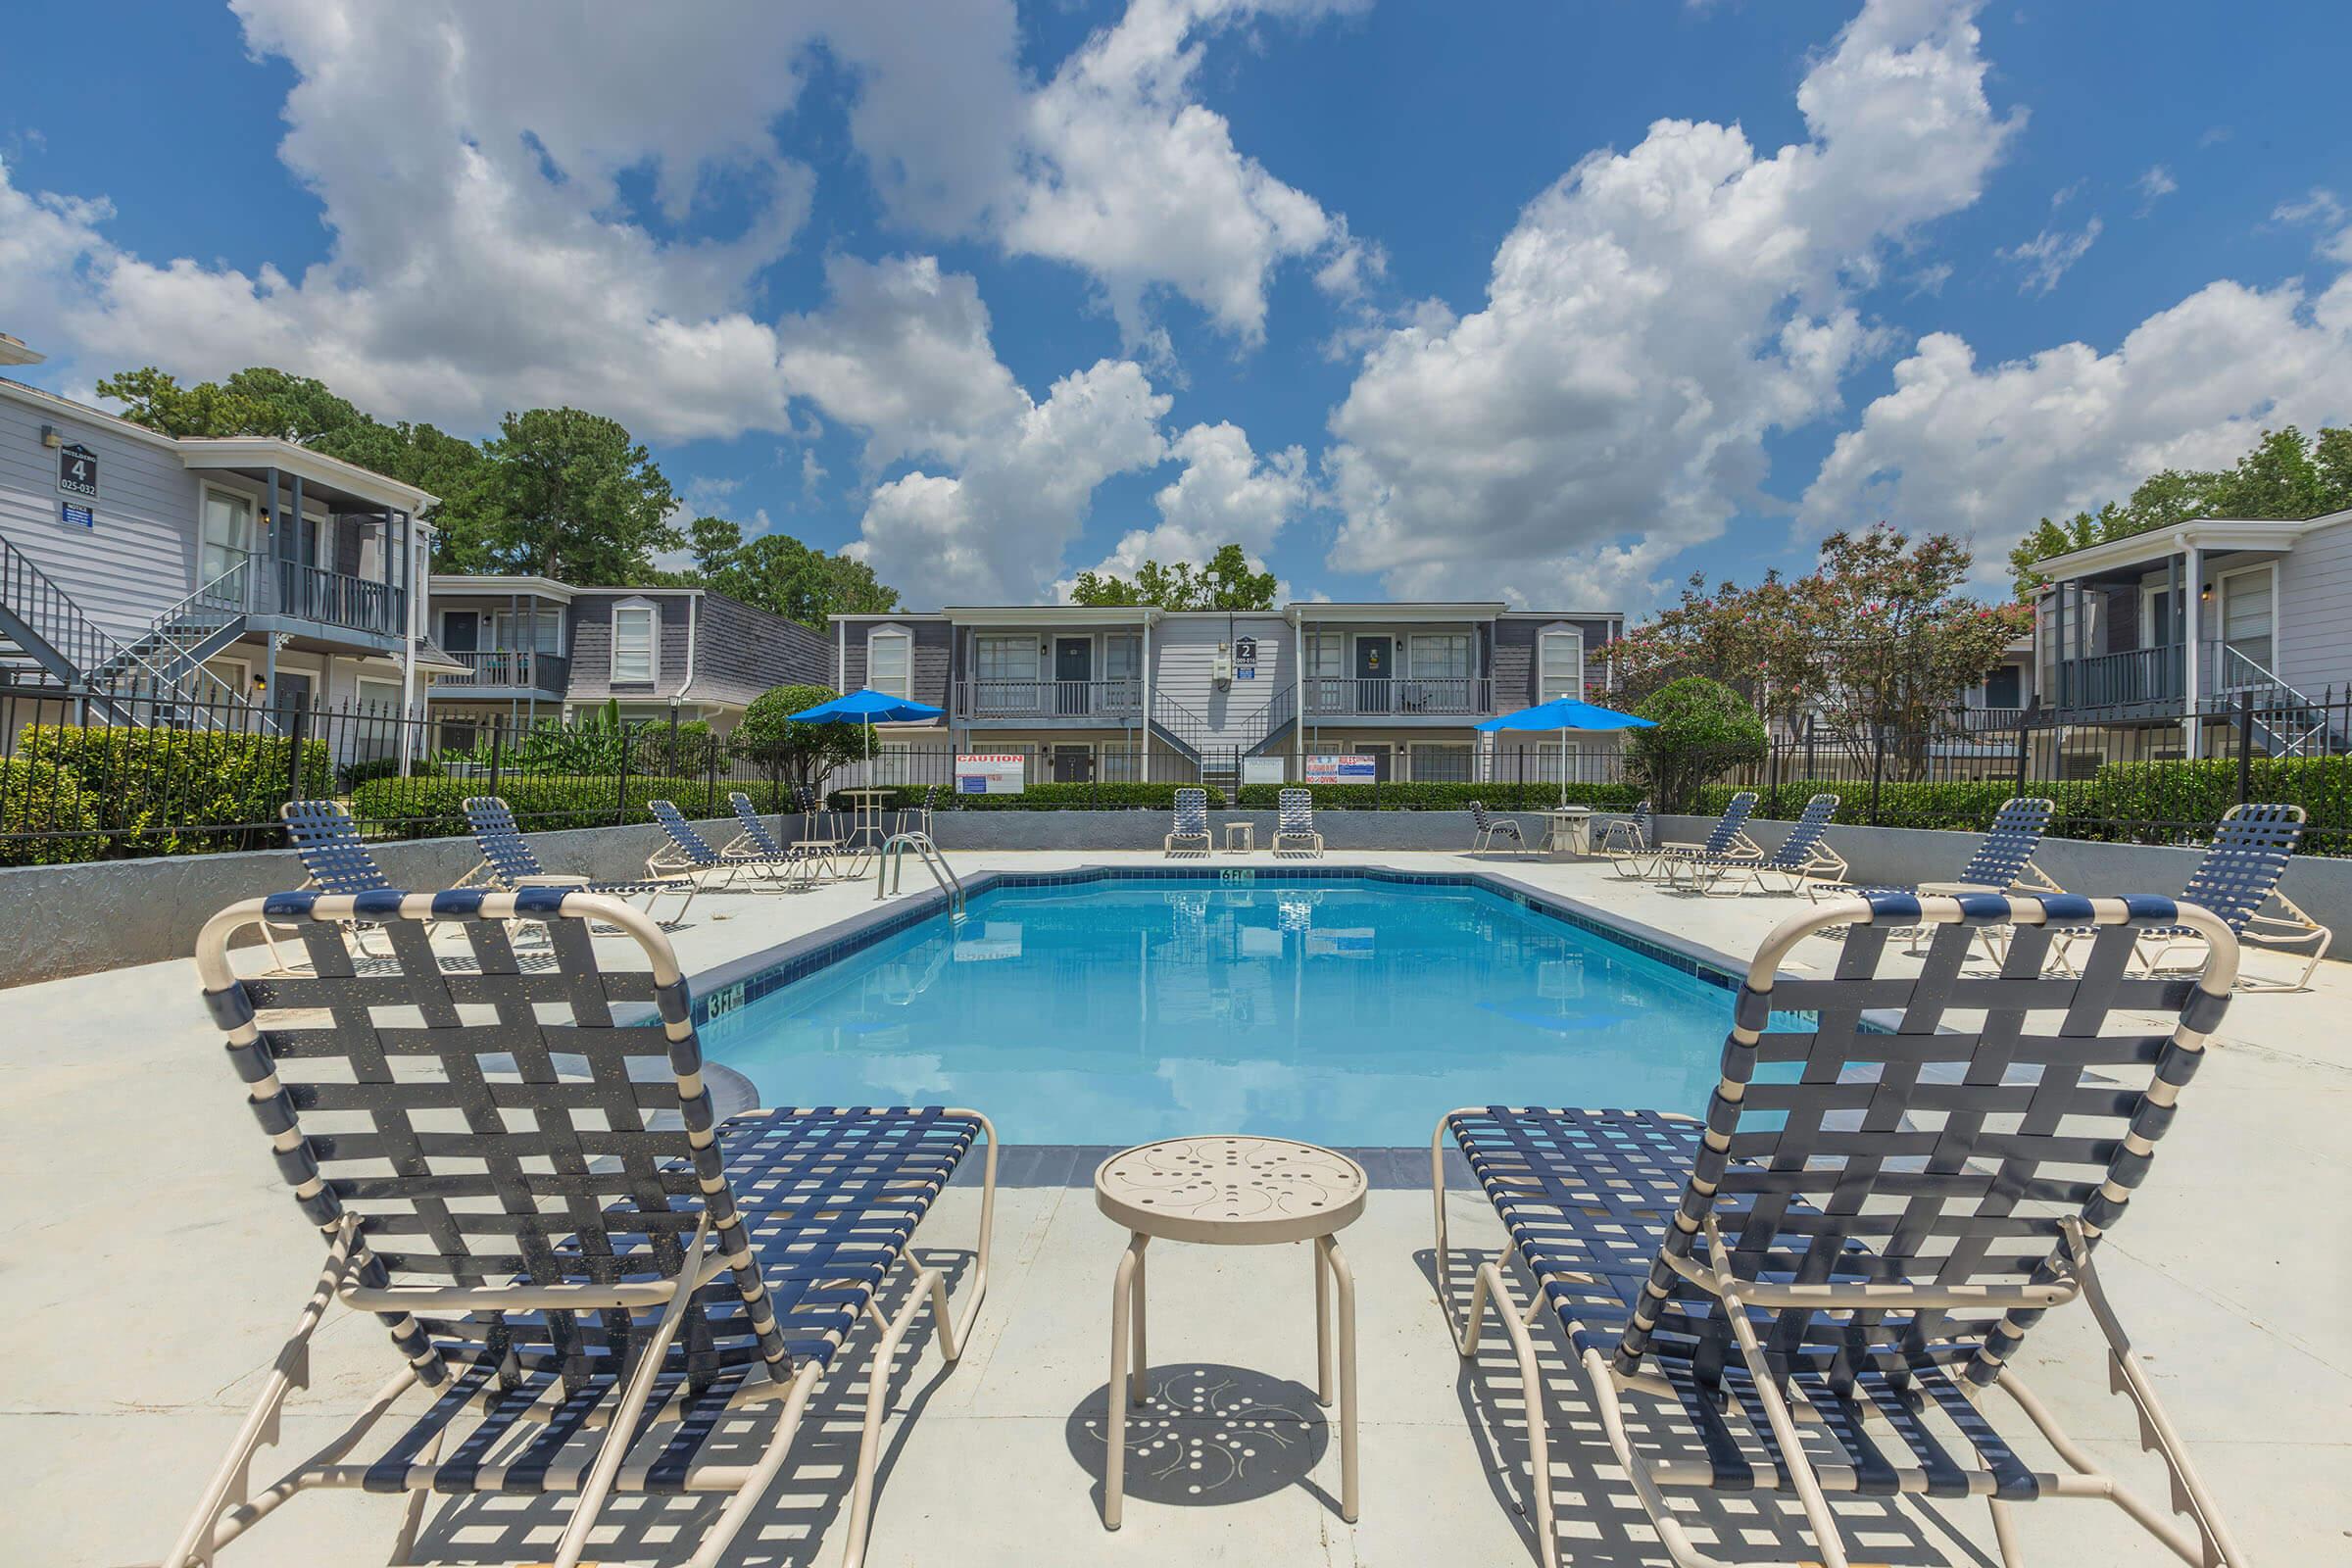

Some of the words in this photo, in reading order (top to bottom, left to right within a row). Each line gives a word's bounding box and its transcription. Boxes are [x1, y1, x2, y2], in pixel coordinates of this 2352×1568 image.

[72, 460, 86, 480] 4
[62, 479, 95, 495] 025-032
[1242, 645, 1250, 657] 2
[1222, 869, 1230, 879] 6
[1232, 869, 1243, 879] FT
[710, 994, 720, 1018] 3
[721, 988, 732, 1014] FT
